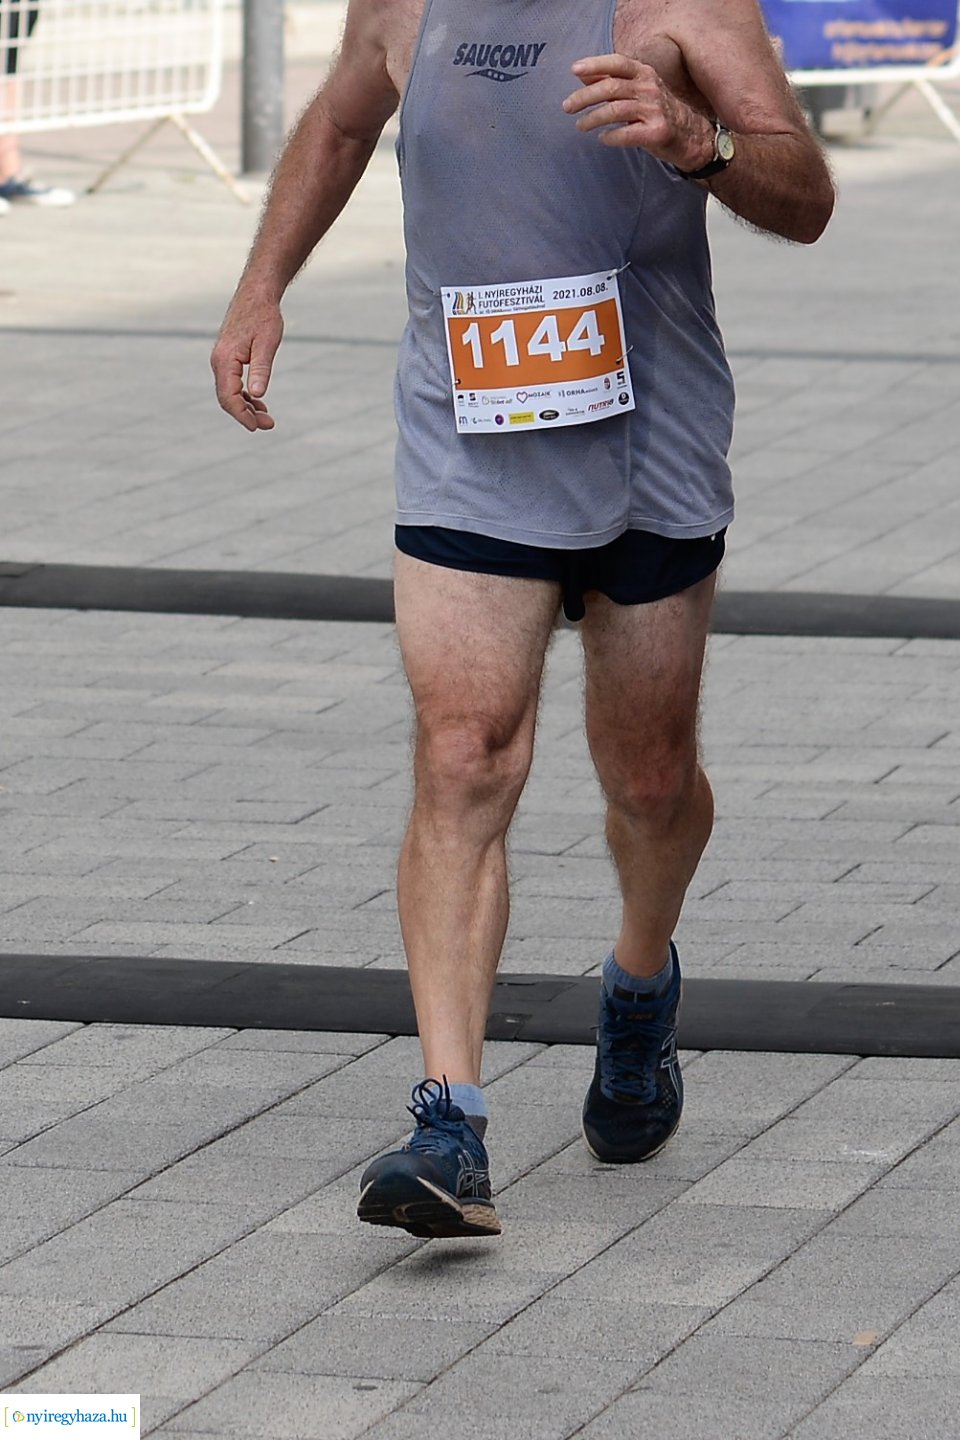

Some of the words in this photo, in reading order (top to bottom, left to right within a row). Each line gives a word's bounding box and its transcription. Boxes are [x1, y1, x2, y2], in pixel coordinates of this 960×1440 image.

[453, 42, 547, 68] SAUCONY
[553, 282, 608, 300] 2021.08.08.
[462, 310, 605, 368] 1144
